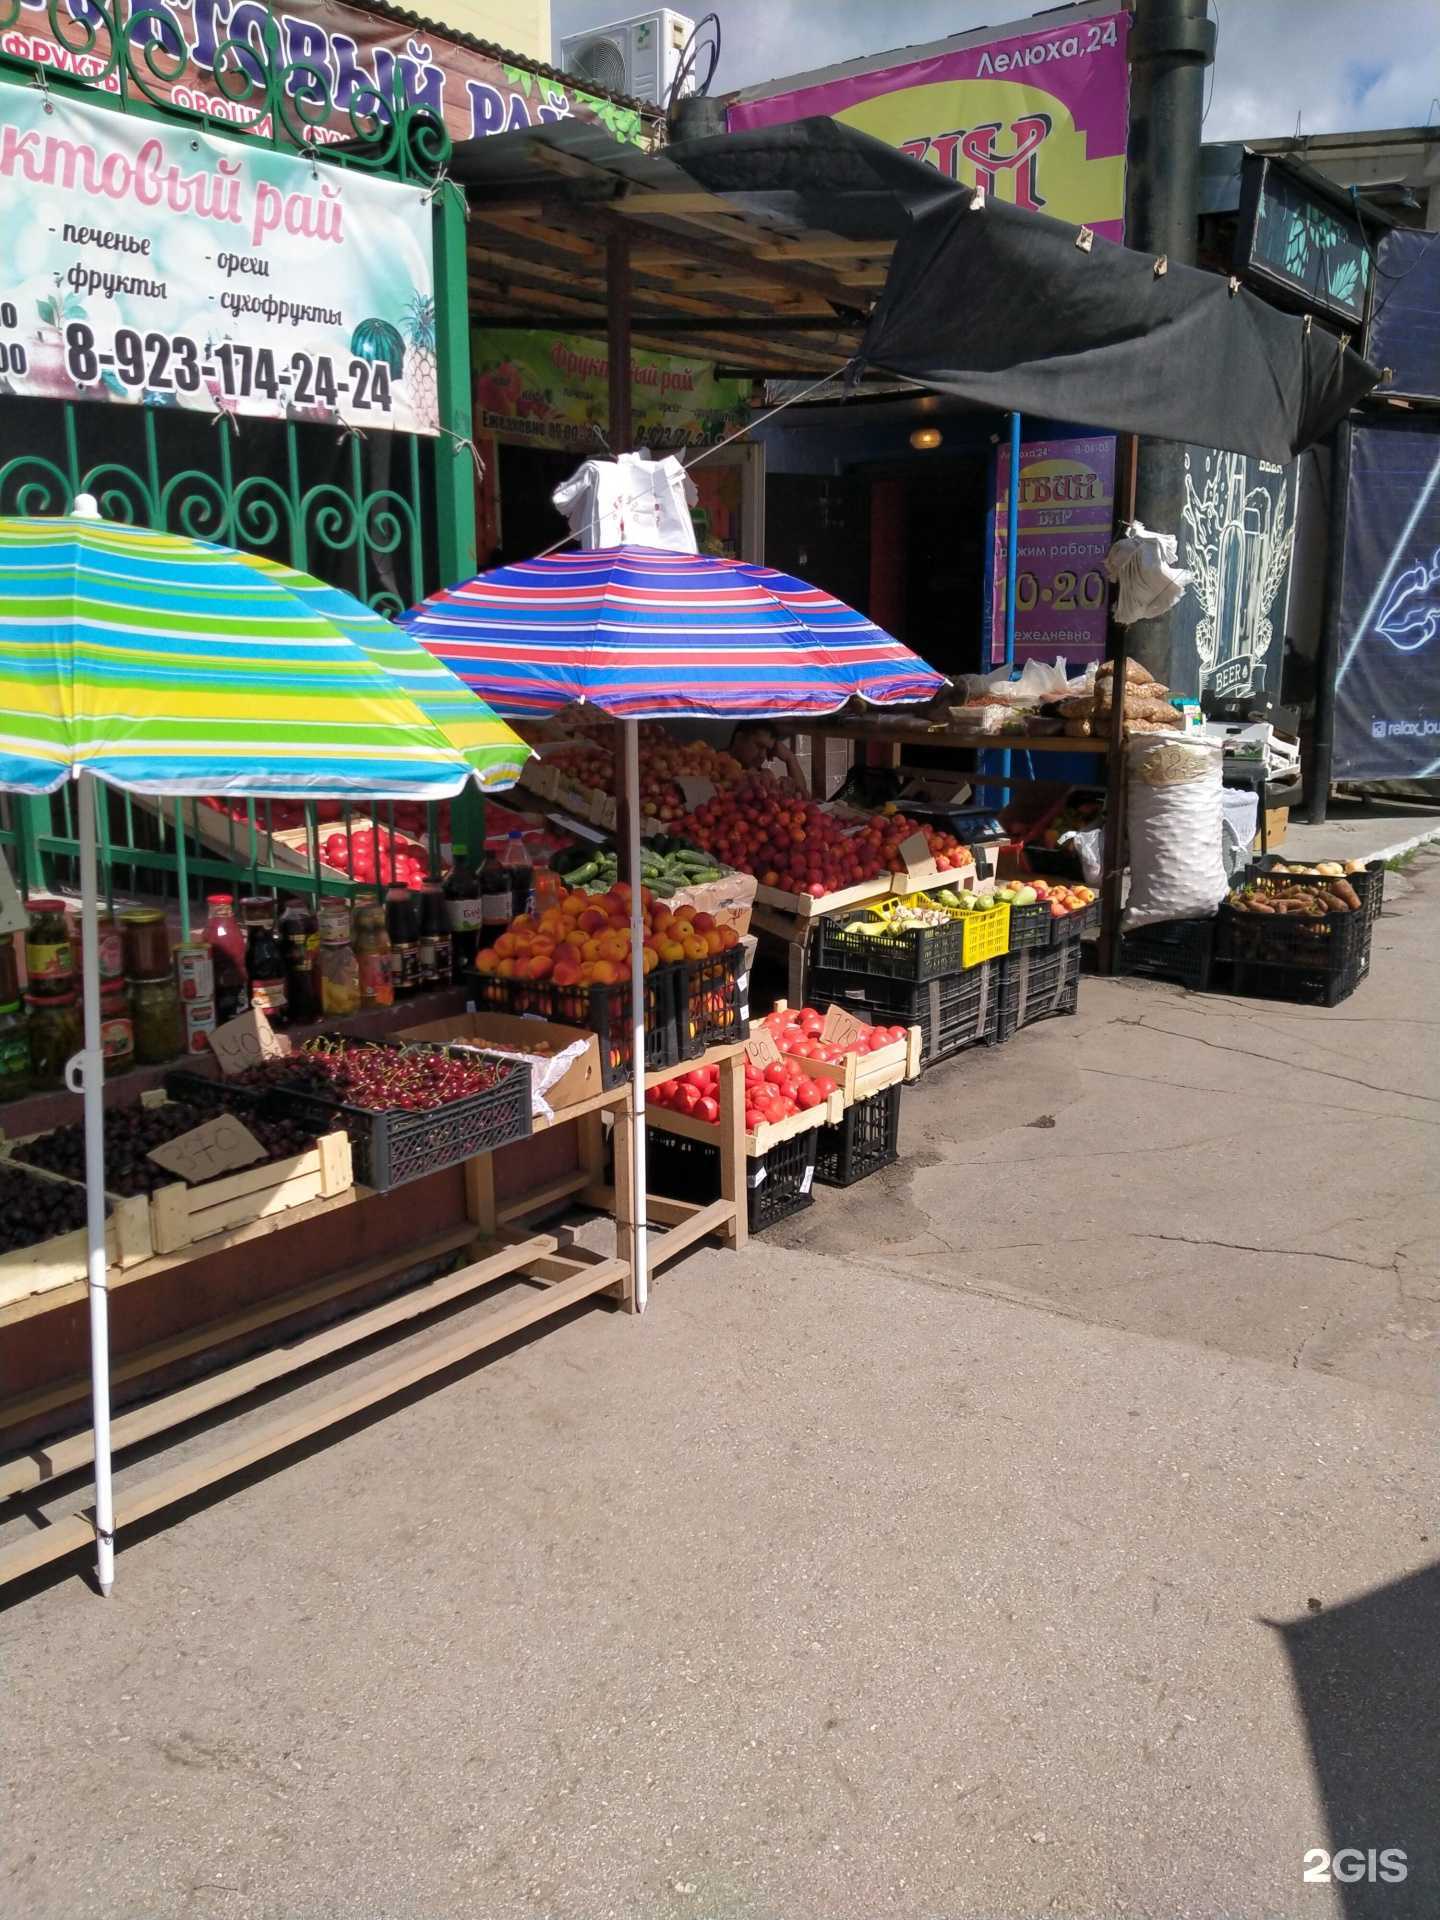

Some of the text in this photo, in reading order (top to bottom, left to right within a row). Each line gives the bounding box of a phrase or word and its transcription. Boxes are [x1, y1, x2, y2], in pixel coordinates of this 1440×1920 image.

[251, 183, 344, 246] рай
[62, 223, 152, 256] печенье
[217, 249, 270, 278] орехи
[67, 263, 168, 300] фрукты
[219, 289, 343, 326] сухофрукты
[65, 322, 392, 412] 8-923-174-24-24
[1050, 542, 1105, 557] работы
[1215, 663, 1242, 692] BEER
